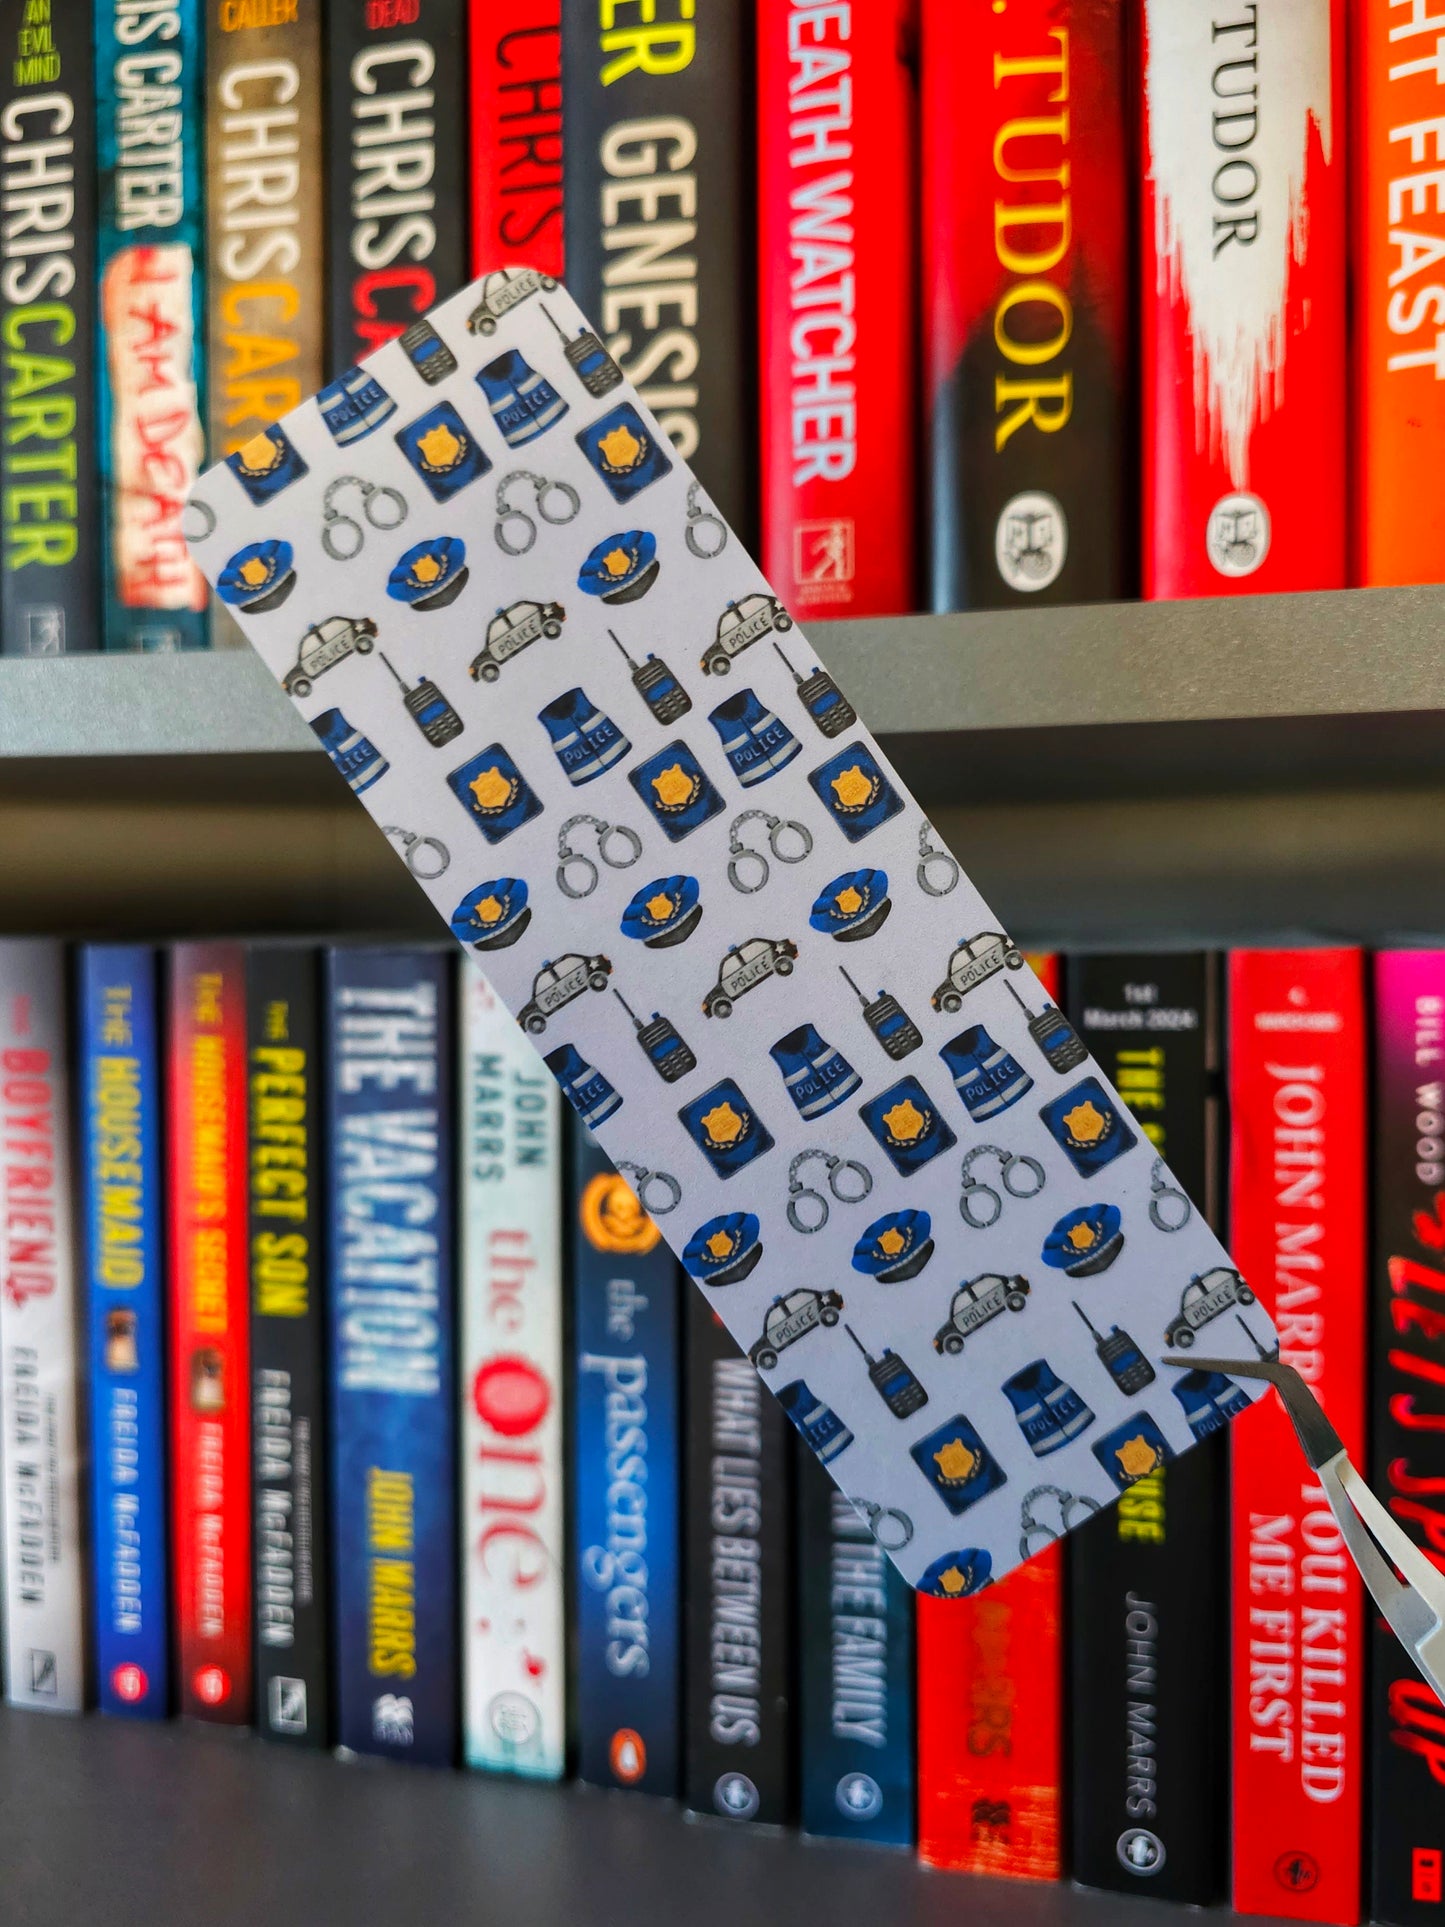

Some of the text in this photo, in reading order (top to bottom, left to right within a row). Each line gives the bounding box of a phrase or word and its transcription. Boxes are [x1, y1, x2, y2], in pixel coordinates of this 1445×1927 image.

[14, 50, 61, 87] MIND
[114, 50, 184, 231] CARTER
[495, 26, 563, 249] CHRIS
[1210, 5, 1259, 262] TUDOR
[789, 0, 857, 488] EATH WATCHER
[993, 26, 1073, 454] TUDOR
[1387, 116, 1445, 382] FEAST
[129, 304, 179, 396] AM
[328, 386, 380, 428] POLICE
[500, 387, 551, 428] POLICE
[134, 407, 191, 597] DEATH
[309, 637, 351, 672] POLICE
[497, 621, 539, 656] POLICE
[728, 615, 769, 649] POLICE
[564, 724, 615, 765] POLICE
[734, 726, 785, 768] POLICE
[544, 973, 585, 1008] POLICE
[730, 958, 771, 991] POLICE
[959, 953, 1000, 986] POLICE
[472, 1053, 505, 1183] MARRS
[513, 1071, 547, 1168] JOHN
[795, 1061, 845, 1099] POLICE
[965, 1062, 1016, 1101] POLICE
[2, 1048, 56, 1299] BOYFRIEND
[96, 1055, 145, 1290] HOUSEMAID
[253, 1046, 309, 1222] PERFECT
[1265, 1062, 1327, 1210] JOHN
[1415, 1081, 1445, 1186] WOOD
[341, 982, 440, 1395] THE VACATION
[254, 1232, 309, 1317] SON
[962, 1294, 1003, 1327] POLICE
[1192, 1289, 1233, 1322] POLICE
[775, 1309, 817, 1343] POLICE
[1027, 1399, 1077, 1436] POLICE
[579, 1352, 651, 1679] passengers
[712, 1456, 761, 1537] LIES
[712, 1537, 761, 1693] BETWEEN
[1249, 1512, 1297, 1763] ME FIRST
[711, 1694, 761, 1748] US
[832, 1616, 888, 1750] FAMILY
[1125, 1591, 1158, 1819] JOHN MARRS
[1301, 1607, 1347, 1804] KILLED
